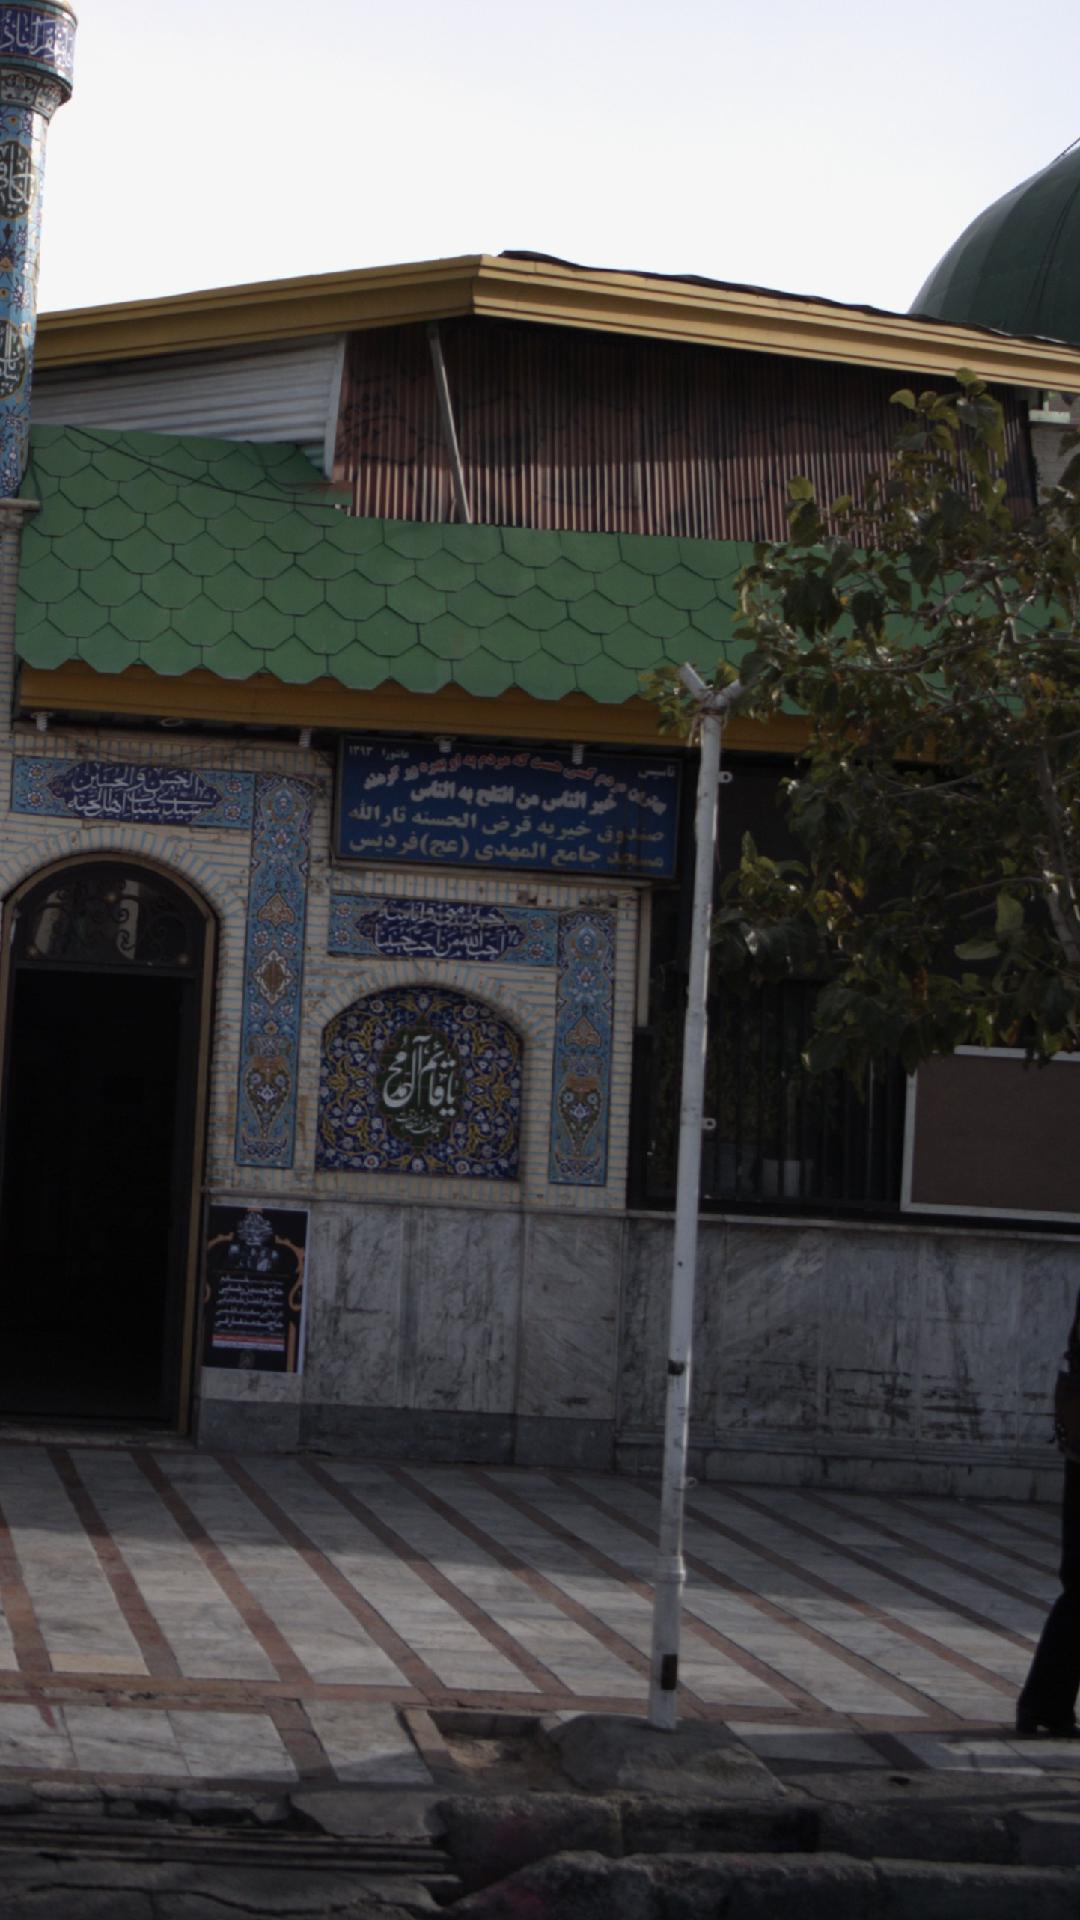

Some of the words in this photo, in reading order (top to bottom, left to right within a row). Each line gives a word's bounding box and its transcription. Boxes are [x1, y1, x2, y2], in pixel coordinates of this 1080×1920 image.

[410, 780, 456, 802] الناس
[541, 790, 587, 812] الناس
[516, 793, 540, 811] من
[412, 812, 477, 829] الحسنه
[482, 815, 532, 837] قرض
[537, 820, 592, 841] خیریه
[597, 825, 664, 844] صندوق
[475, 841, 547, 862] المهدی
[551, 844, 601, 868] جامع
[607, 849, 664, 871] مسجد
